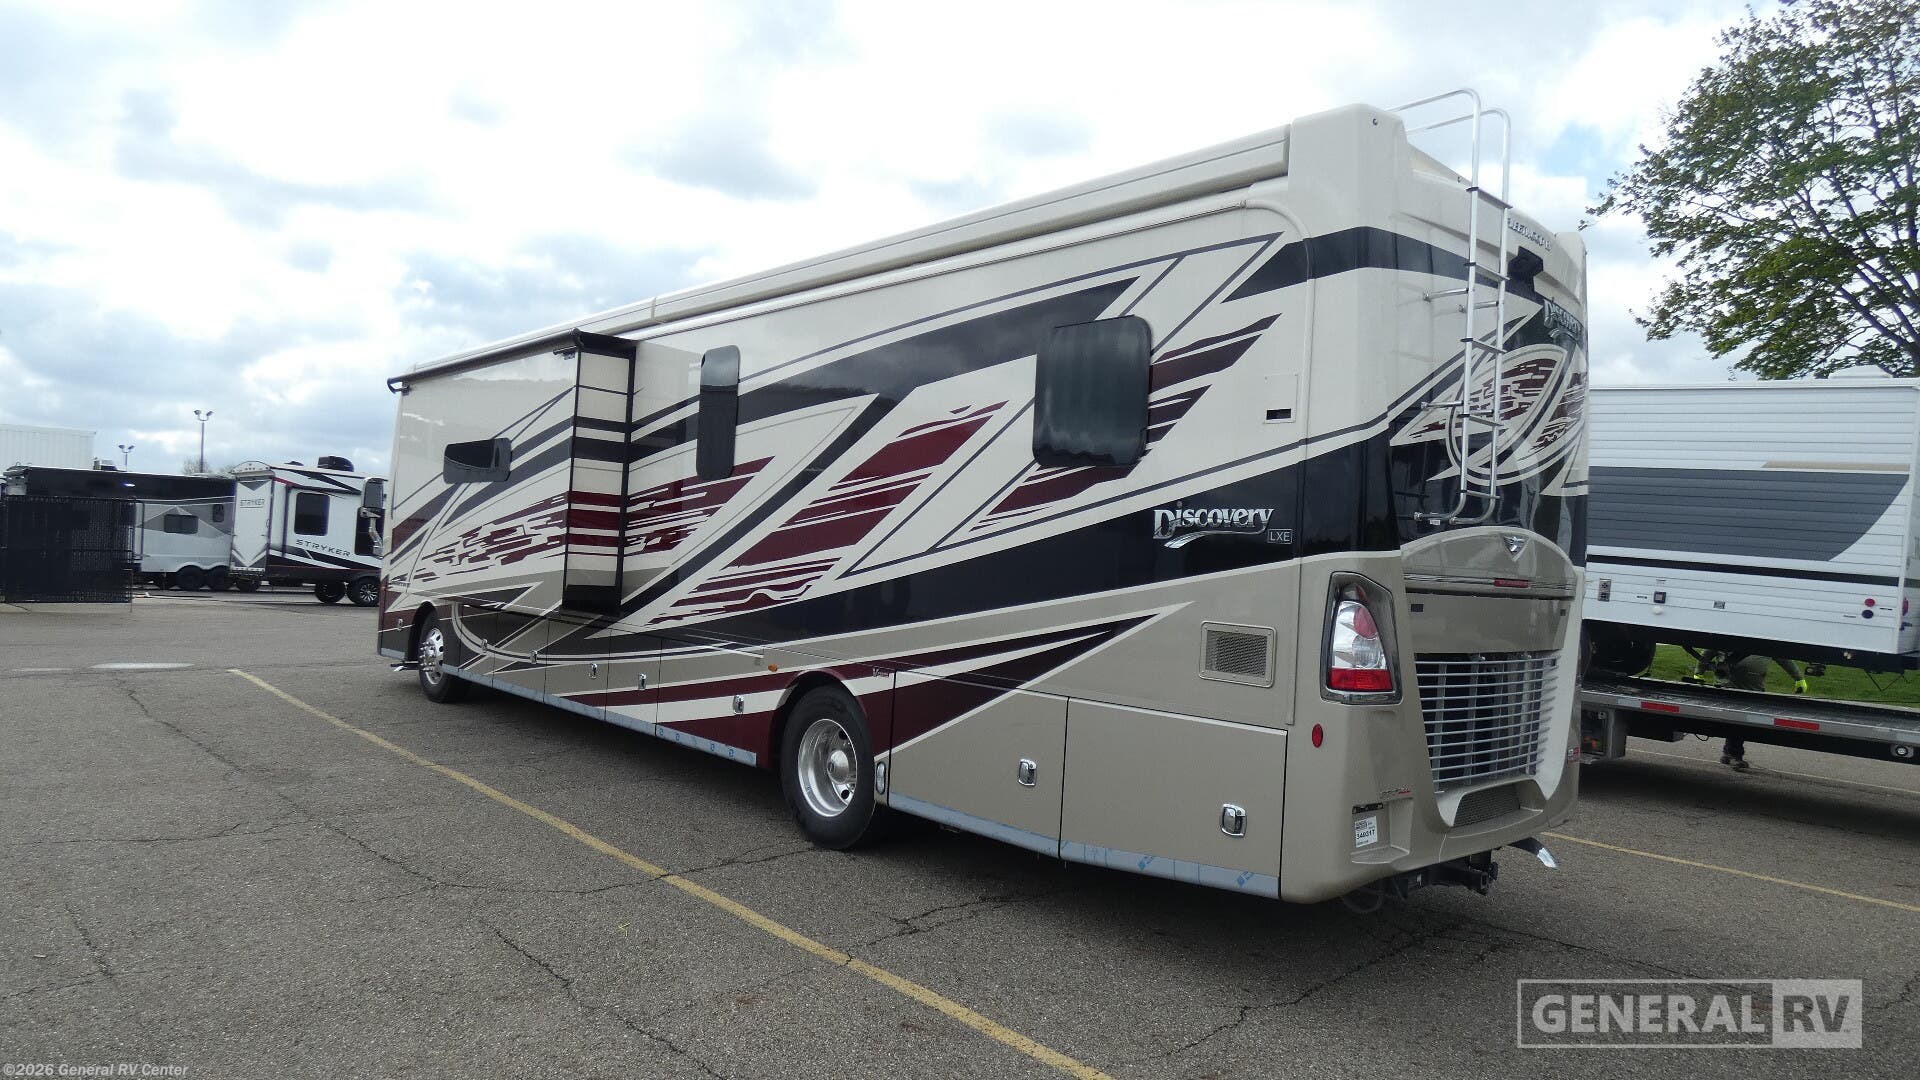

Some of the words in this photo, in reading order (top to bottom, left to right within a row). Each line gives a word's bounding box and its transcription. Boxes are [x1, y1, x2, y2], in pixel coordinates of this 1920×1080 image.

[1152, 500, 1275, 540] Discovery
[1270, 532, 1290, 541] LXE
[296, 539, 351, 557] STRYKER
